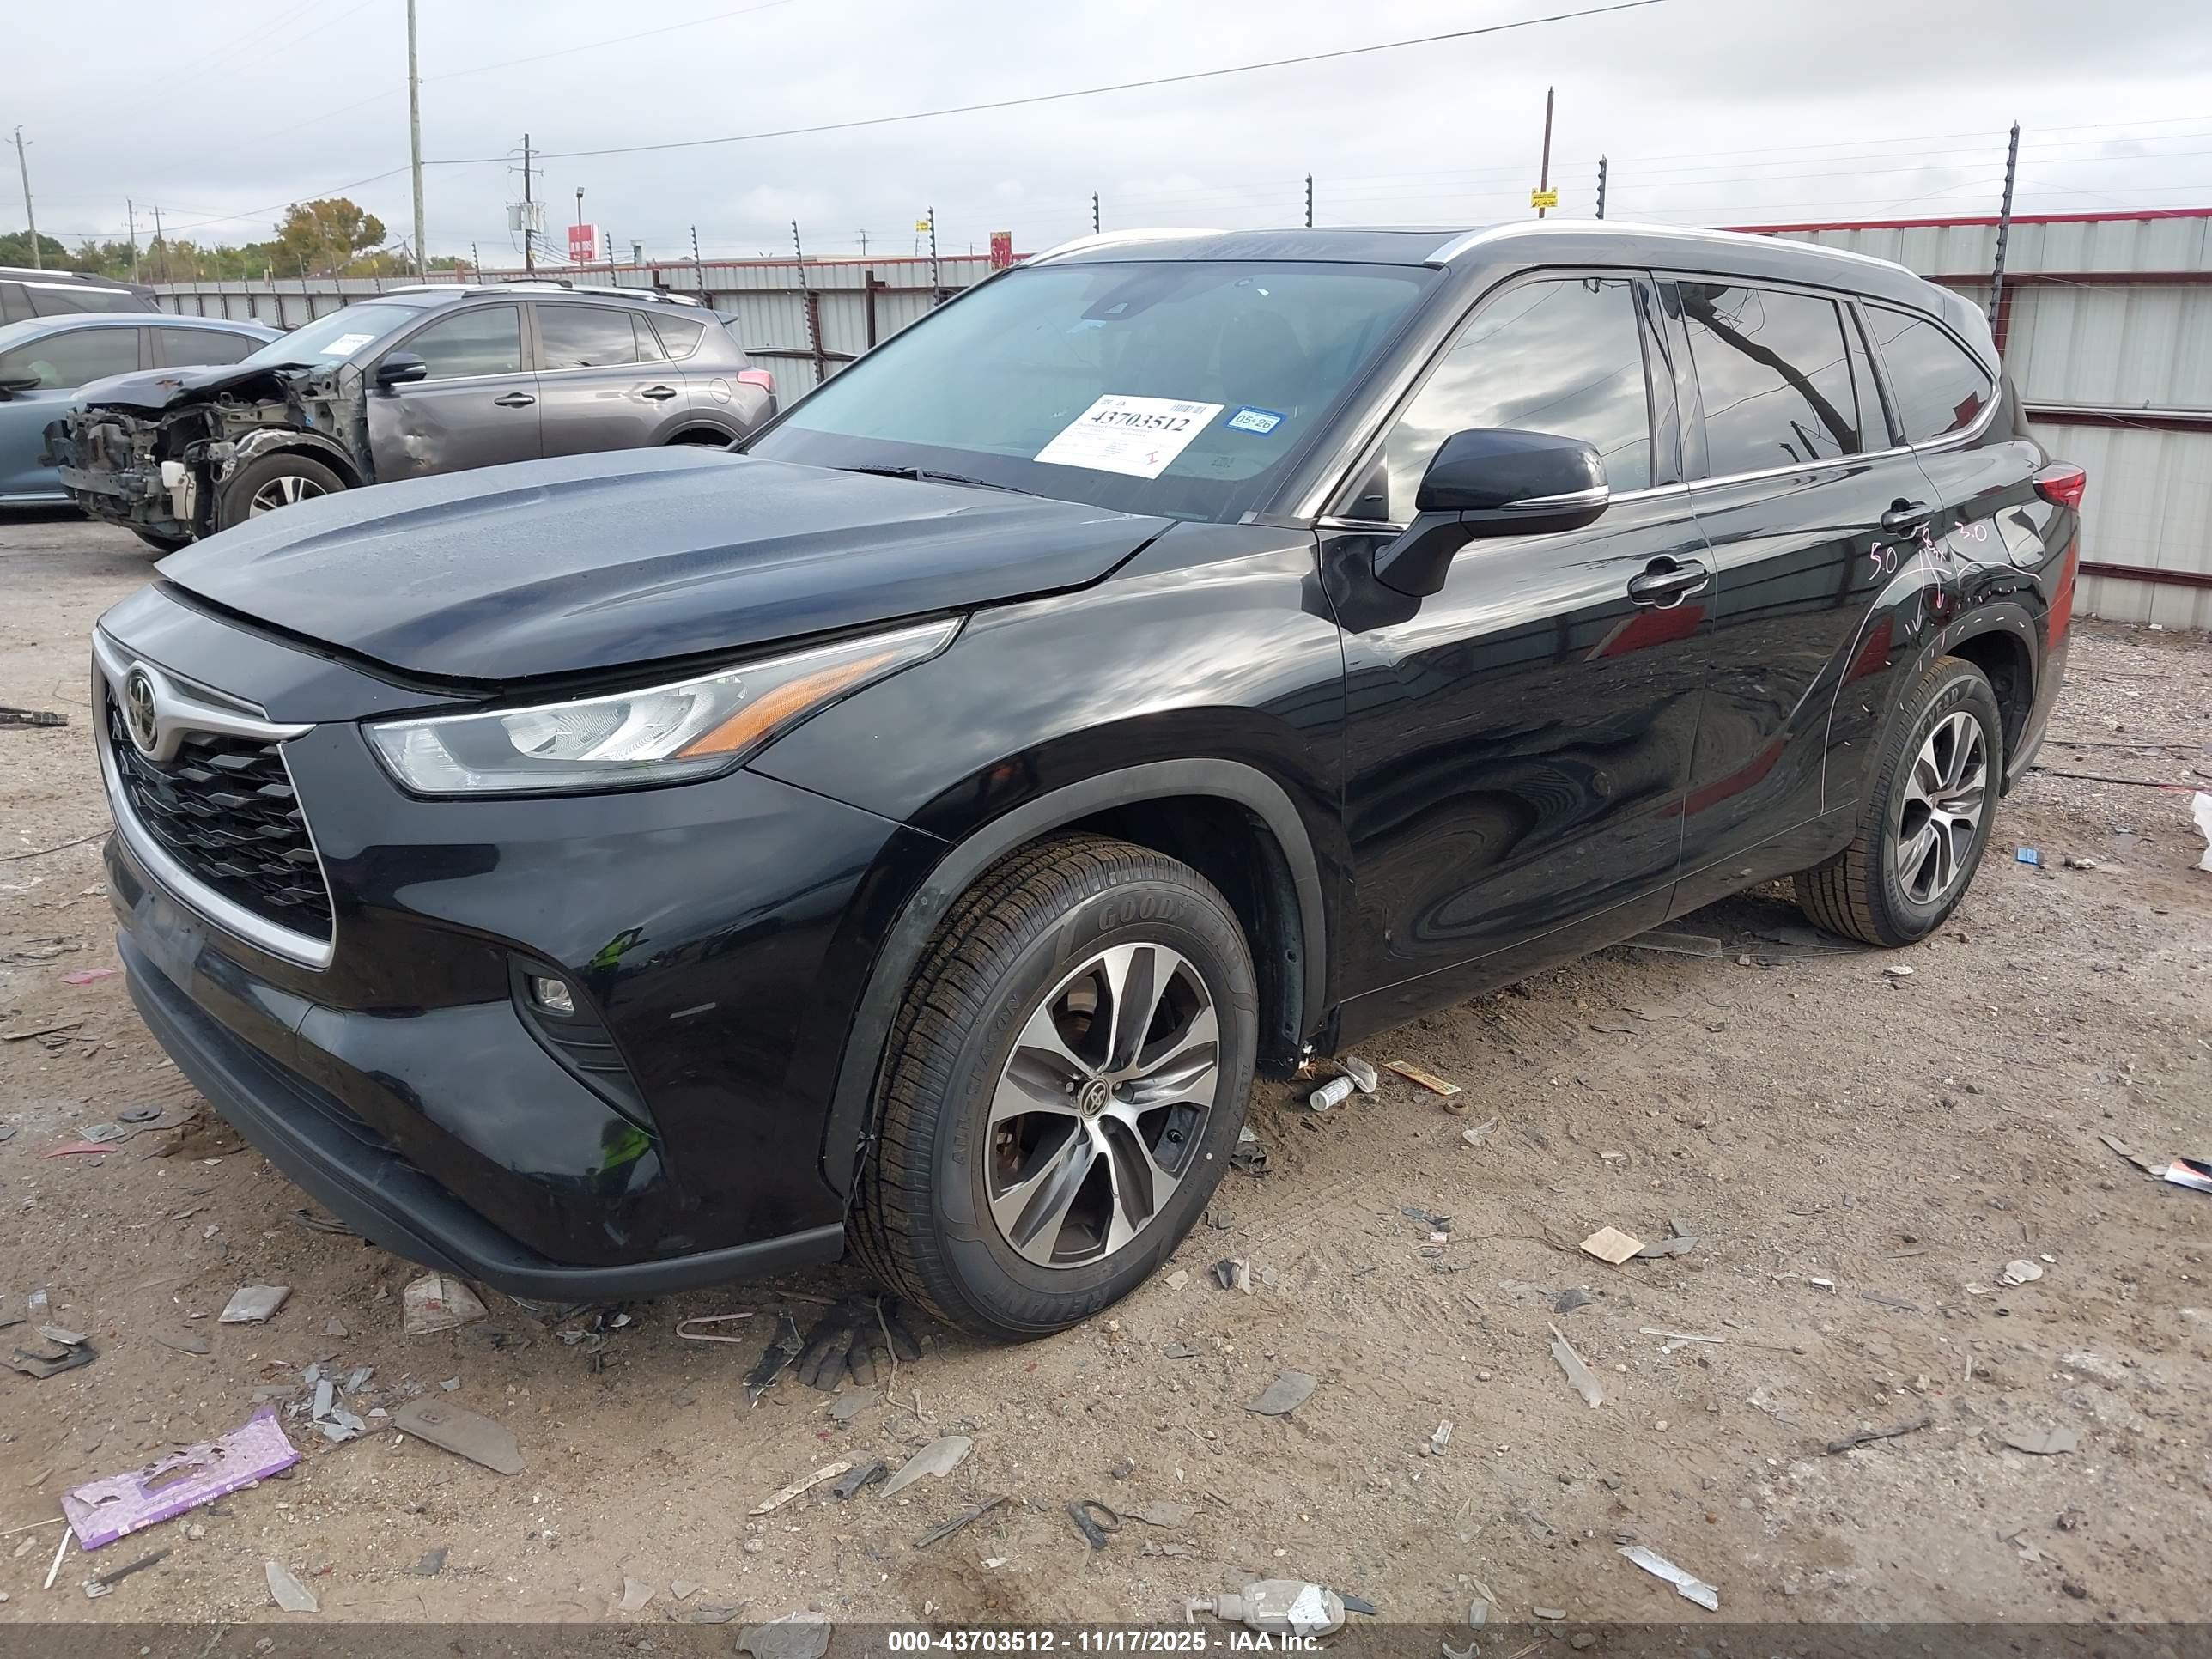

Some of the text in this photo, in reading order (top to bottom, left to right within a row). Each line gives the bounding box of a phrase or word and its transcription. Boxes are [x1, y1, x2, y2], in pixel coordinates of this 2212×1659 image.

[1091, 410, 1191, 432] 43703512
[1954, 521, 1987, 542] 3.0
[1869, 542, 1898, 580] 5.0
